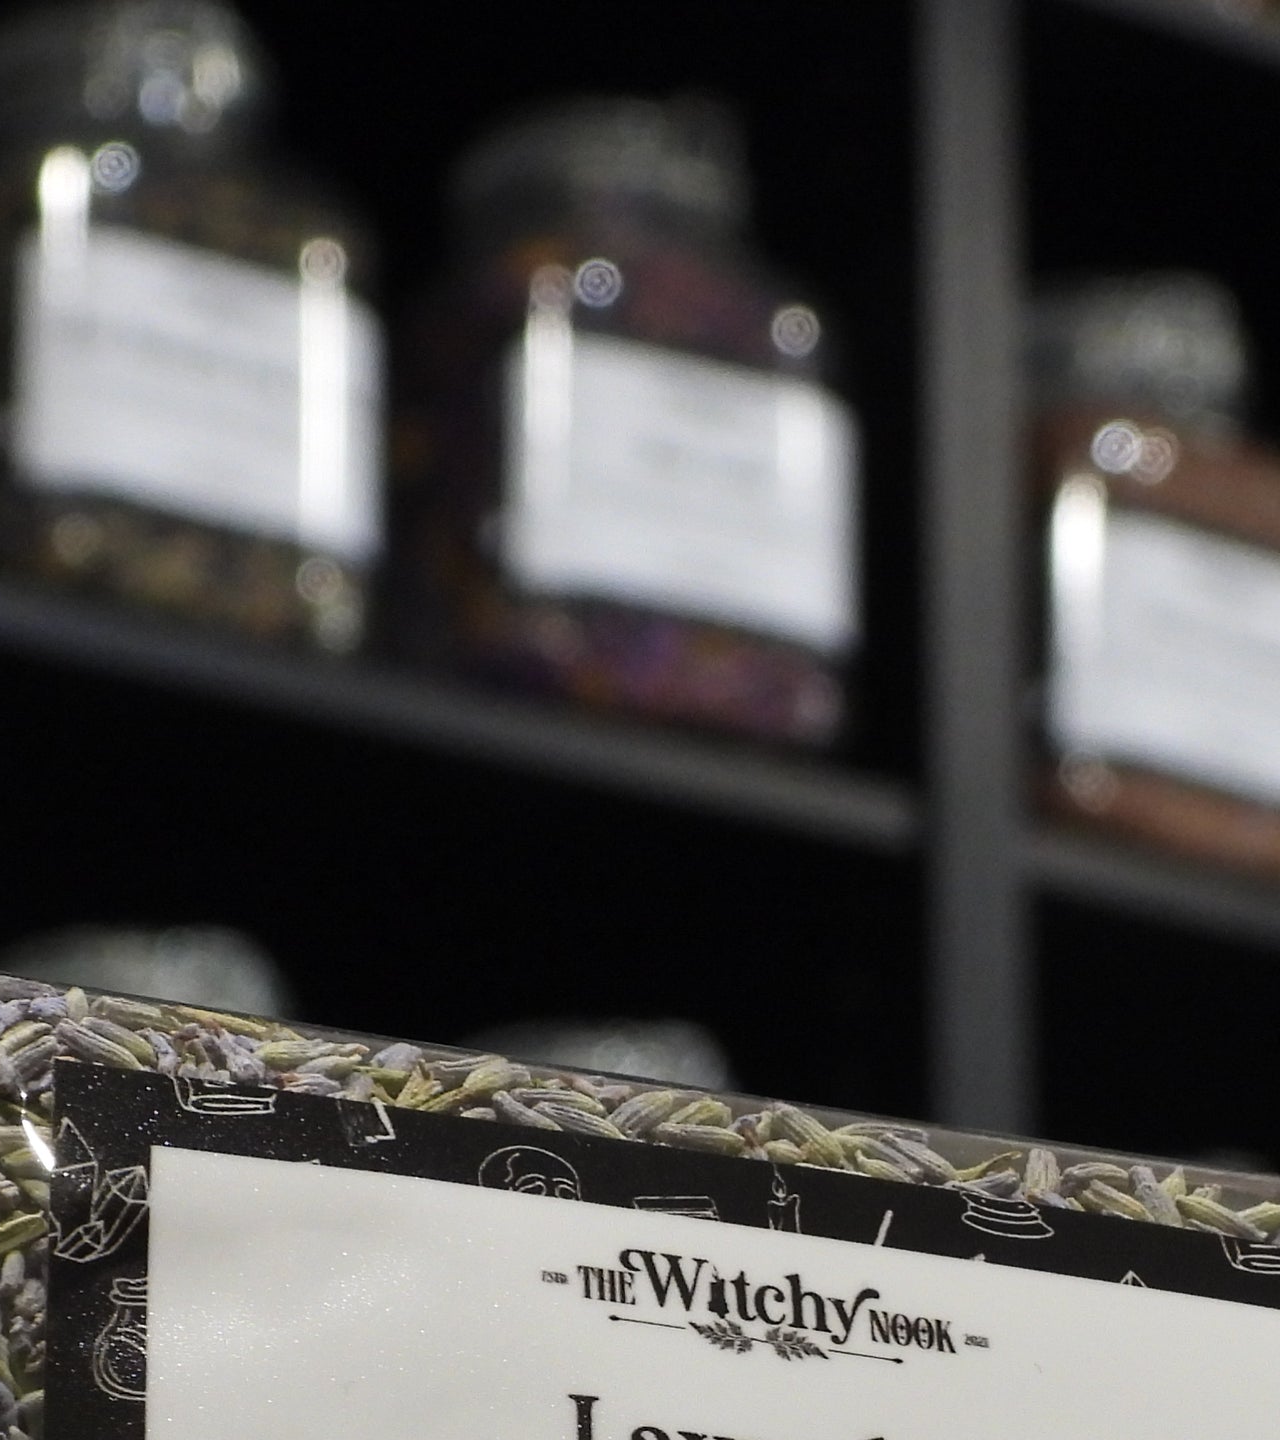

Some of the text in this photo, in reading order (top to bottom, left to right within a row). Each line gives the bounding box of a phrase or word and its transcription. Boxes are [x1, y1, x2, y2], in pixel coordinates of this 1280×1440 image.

[576, 1265, 636, 1305] THE
[618, 1249, 880, 1345] Witchy
[868, 1309, 957, 1354] NOOK
